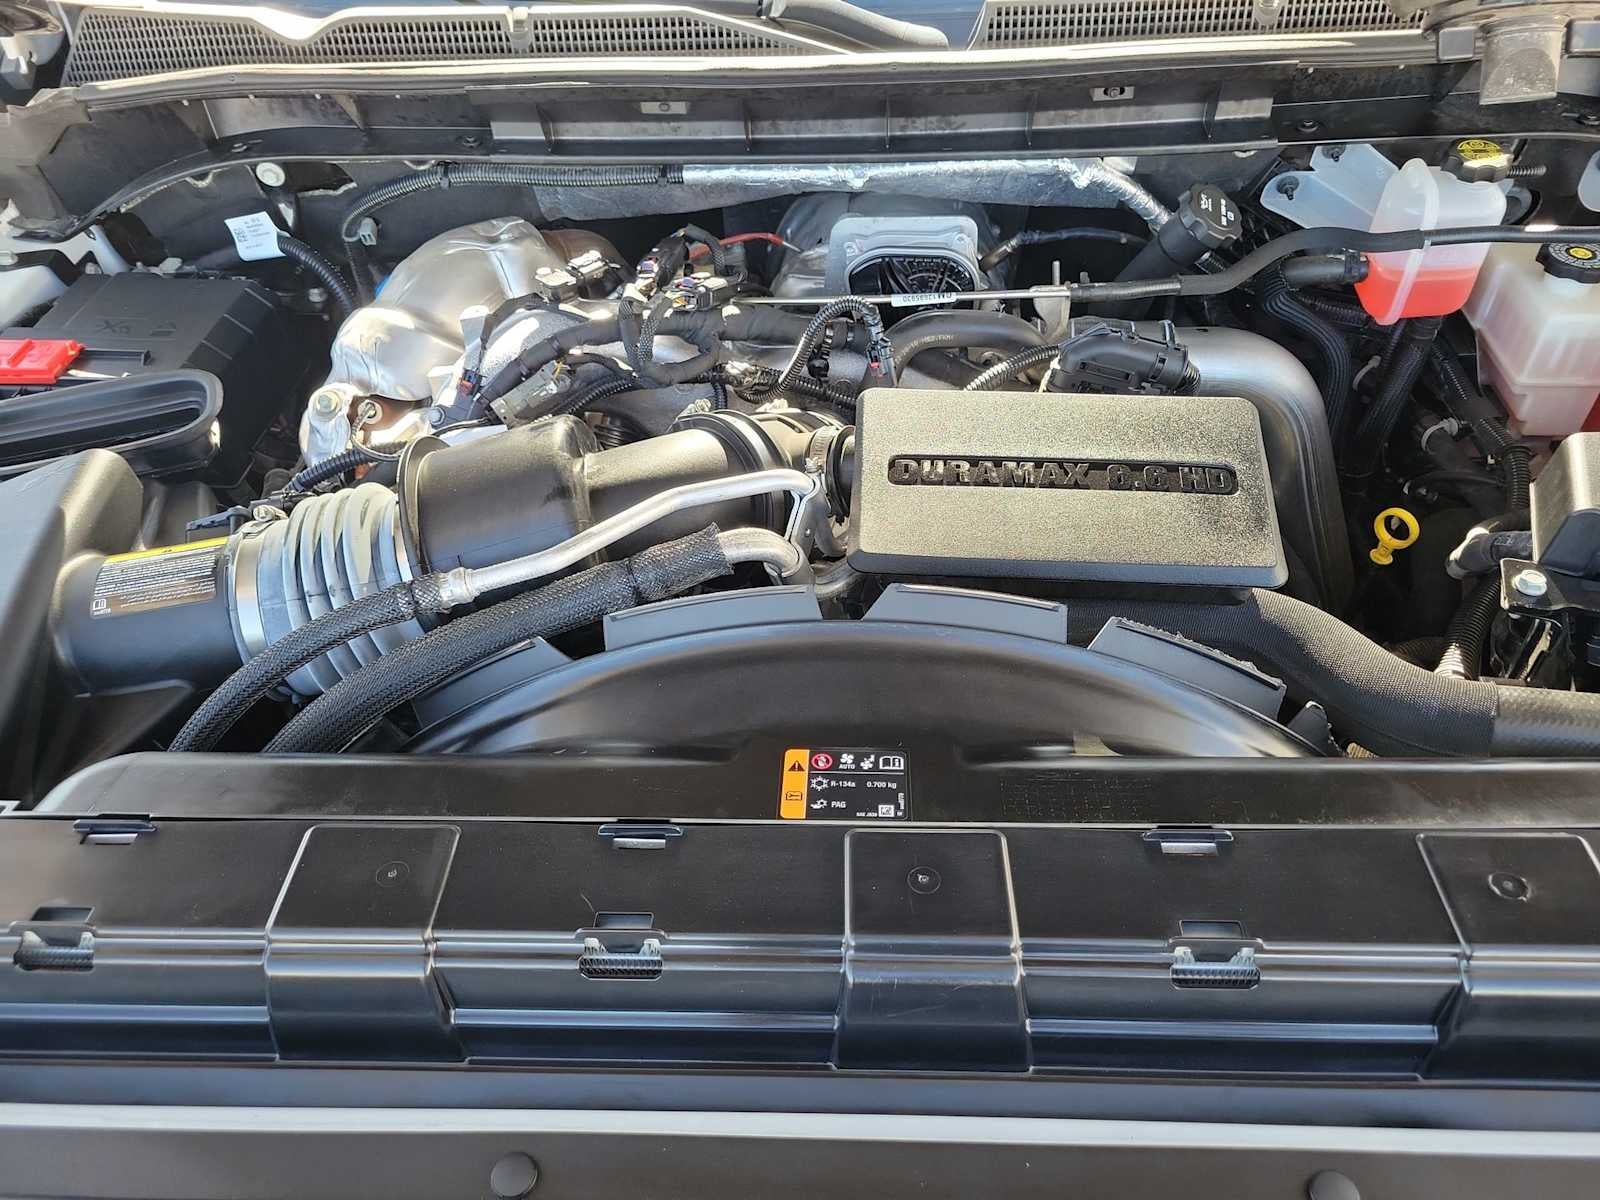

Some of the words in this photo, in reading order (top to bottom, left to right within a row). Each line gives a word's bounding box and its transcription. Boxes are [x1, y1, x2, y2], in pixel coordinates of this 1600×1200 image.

[893, 459, 1090, 487] DURAMAX
[1106, 464, 1169, 490] 6.6
[1178, 466, 1234, 493] HD
[866, 781, 887, 789] 0.700
[887, 781, 898, 790] kg
[831, 801, 847, 809] PAG
